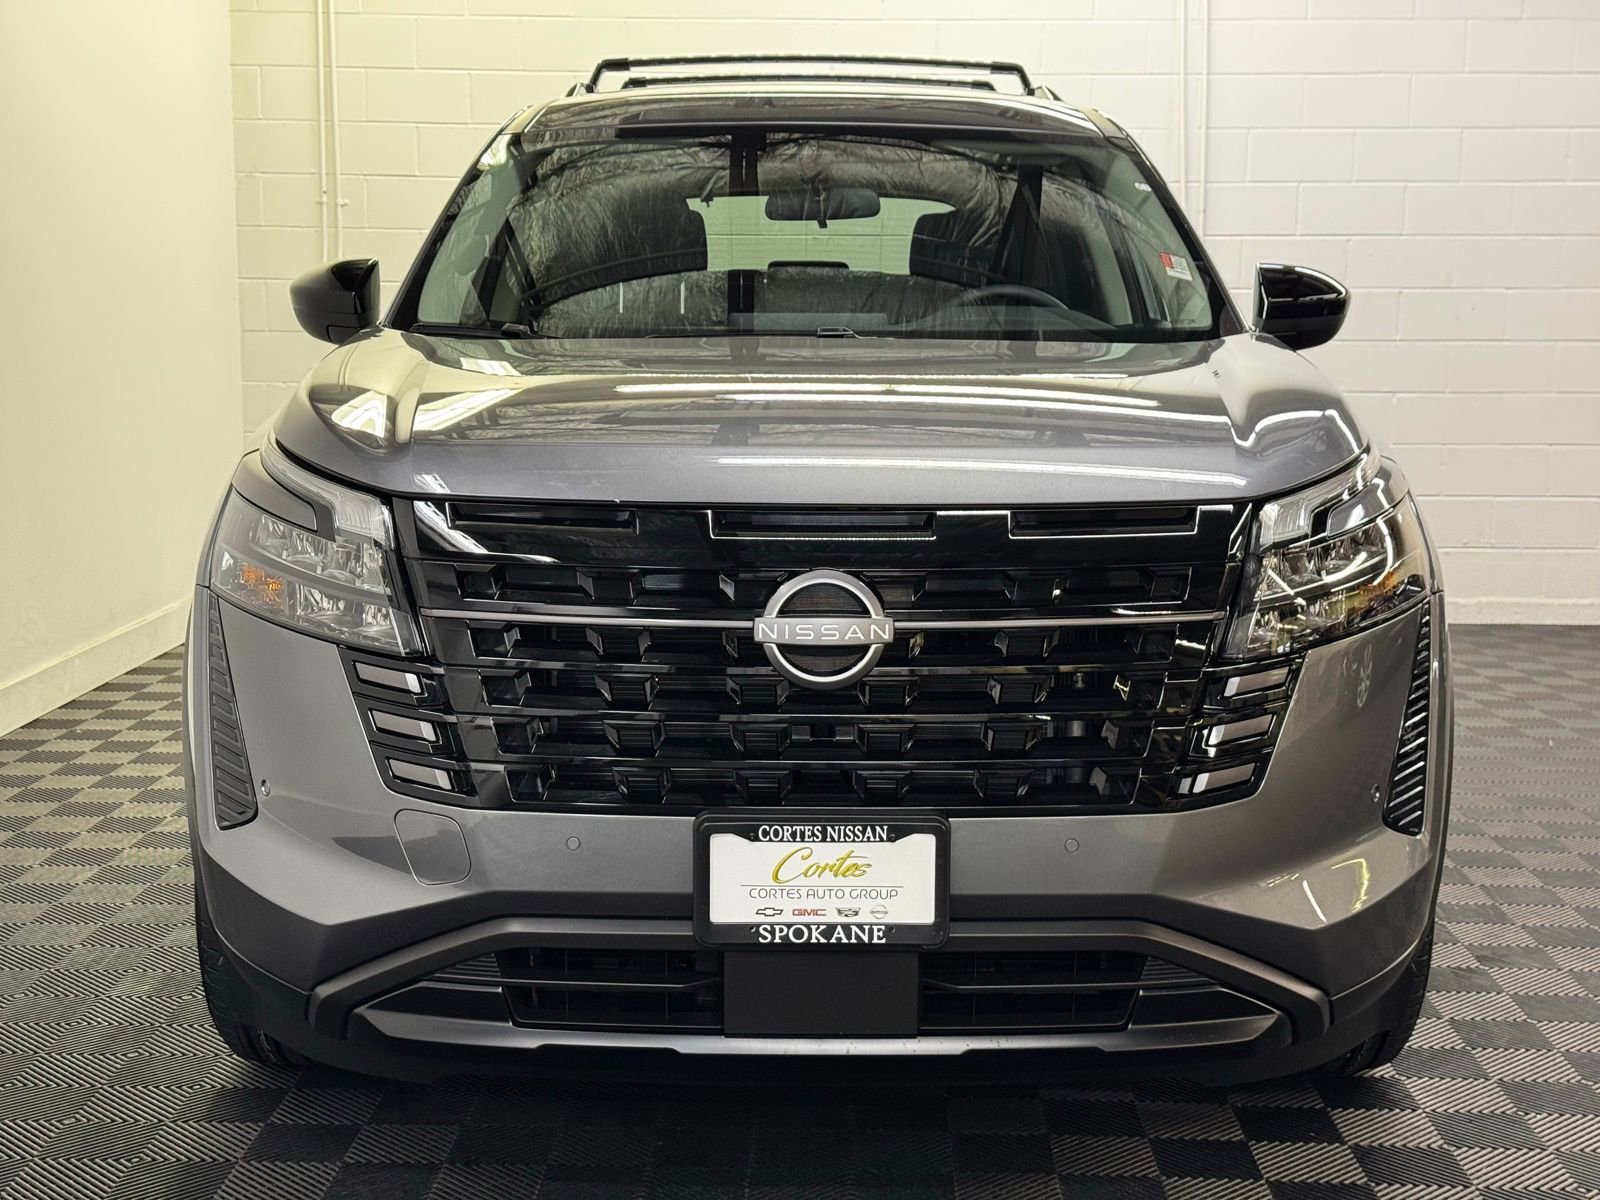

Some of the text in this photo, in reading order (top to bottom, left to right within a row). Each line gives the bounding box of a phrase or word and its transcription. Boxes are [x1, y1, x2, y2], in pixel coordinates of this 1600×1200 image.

[758, 623, 889, 640] NISSAN
[758, 825, 888, 842] CORTES NISSAN
[771, 846, 873, 885] Cortes
[749, 887, 899, 900] CORTES AUTO GROUP
[791, 907, 828, 917] GMC
[758, 924, 887, 944] SPOKANE
